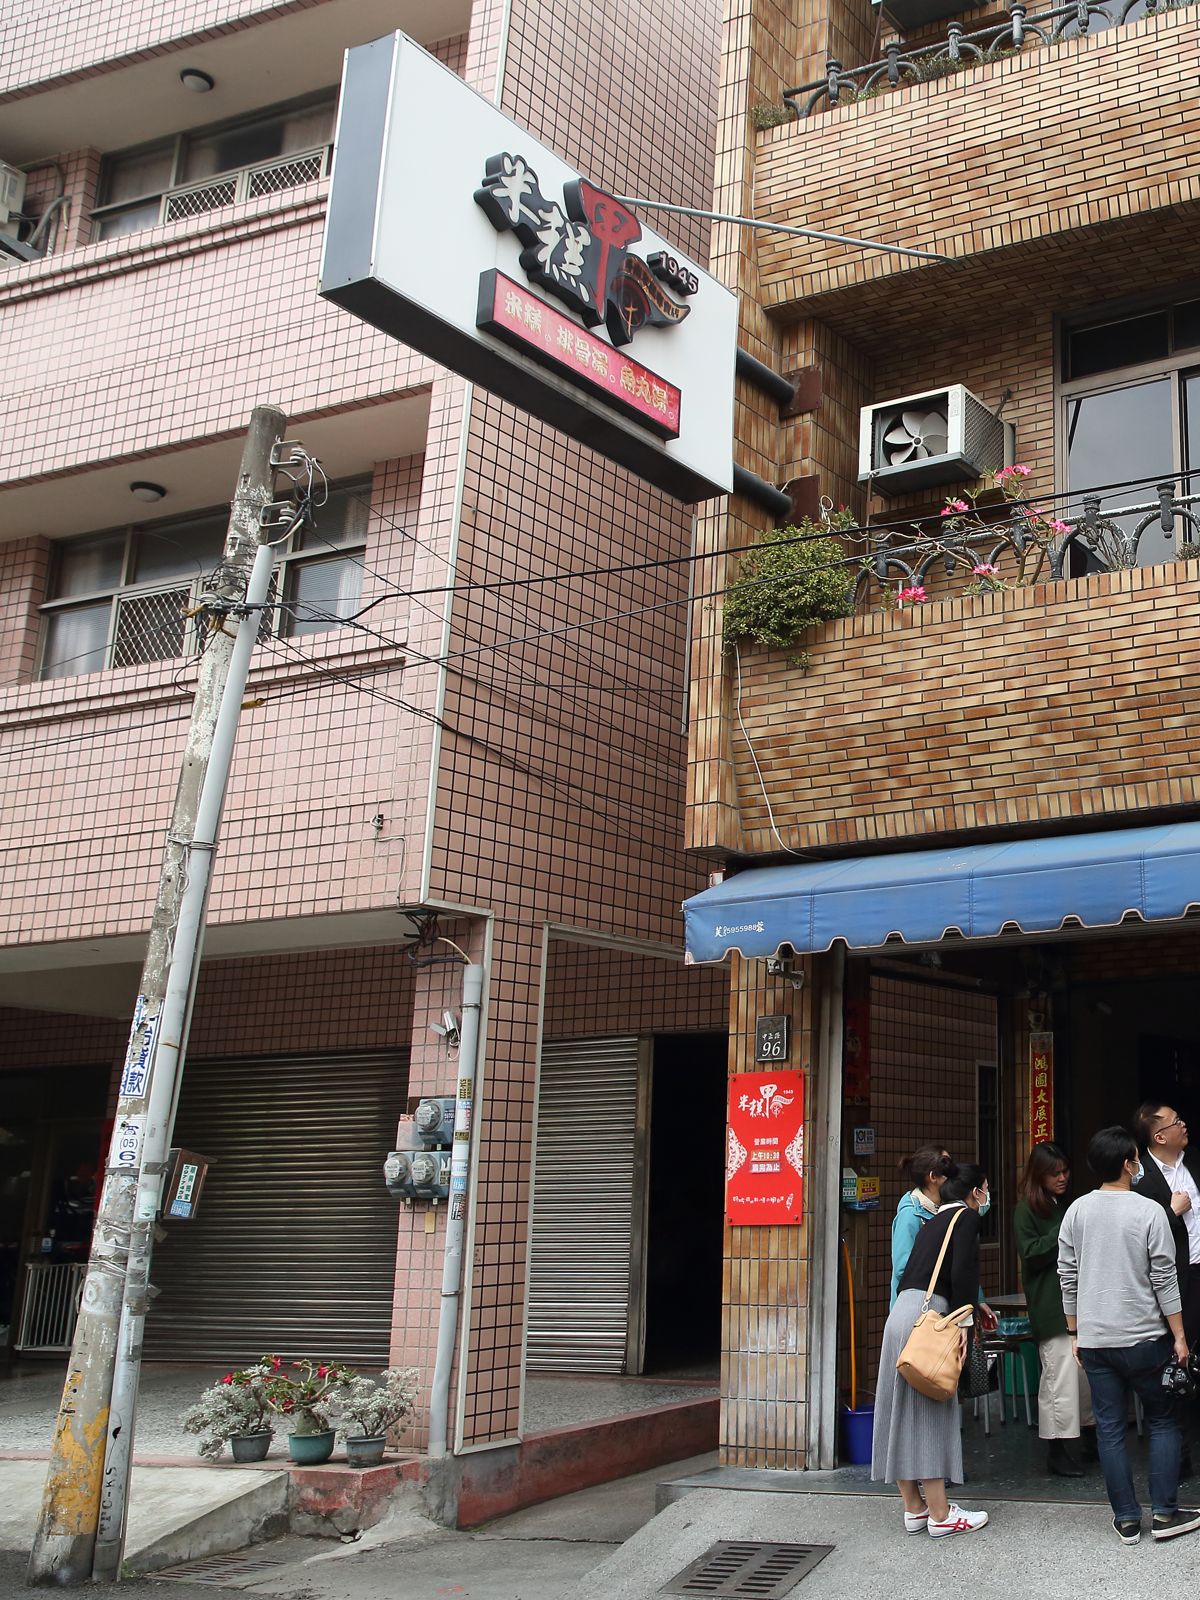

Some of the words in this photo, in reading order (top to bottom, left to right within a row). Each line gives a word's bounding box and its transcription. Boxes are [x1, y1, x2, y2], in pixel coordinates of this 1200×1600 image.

[660, 252, 698, 293] 1945
[761, 1041, 781, 1057] 96
[1033, 1055, 1049, 1144] 鴻圖大展正
[120, 1136, 138, 1150] (05)
